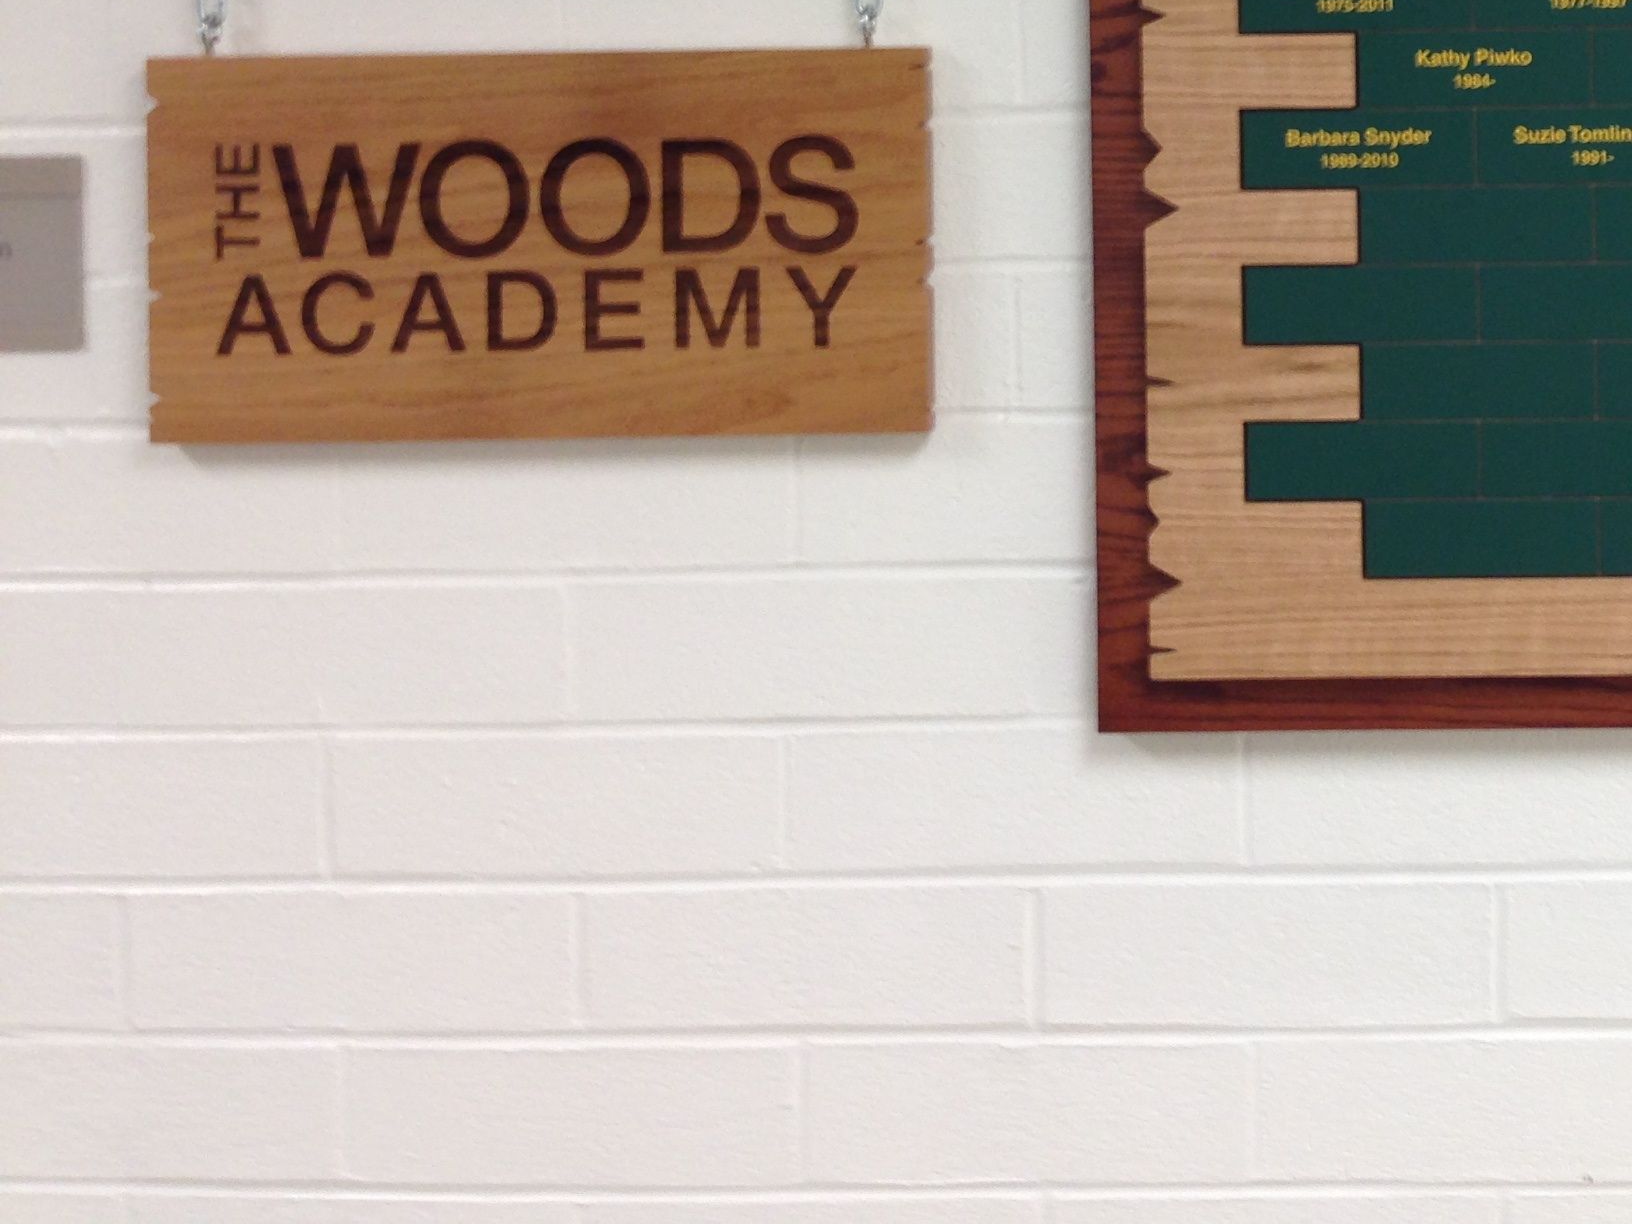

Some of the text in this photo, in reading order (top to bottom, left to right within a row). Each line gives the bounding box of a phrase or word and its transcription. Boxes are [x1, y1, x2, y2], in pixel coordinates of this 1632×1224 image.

[1414, 47, 1533, 70] Kathy Piwko
[1285, 127, 1432, 149] Barbara Snyder
[1513, 125, 1567, 145] Suzie
[1573, 150, 1611, 166] 1991-
[214, 142, 262, 262] THE
[271, 134, 860, 259] WOODS
[216, 265, 859, 356] ACADEMY
